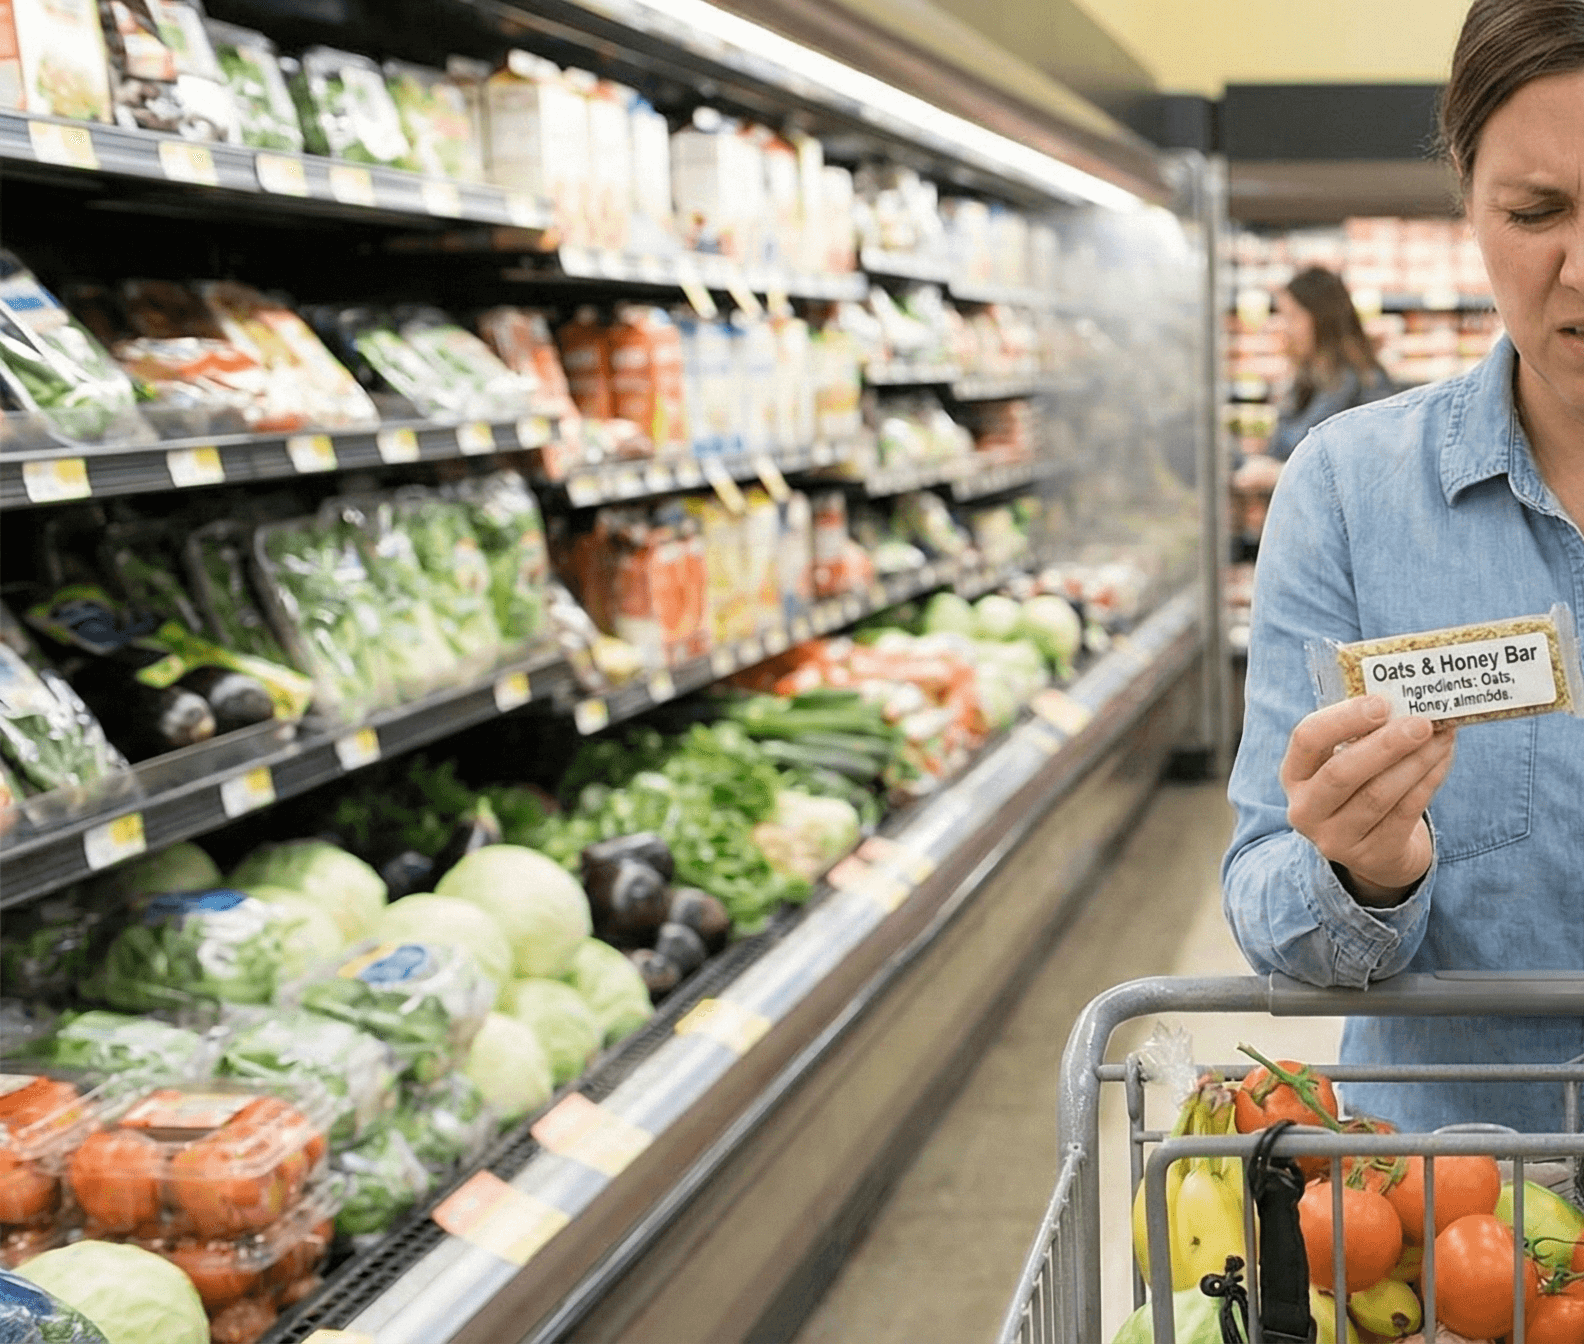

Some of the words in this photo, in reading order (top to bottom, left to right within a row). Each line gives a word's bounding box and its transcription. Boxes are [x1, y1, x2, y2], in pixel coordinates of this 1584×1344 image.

[1372, 662, 1416, 682] Oats
[1421, 657, 1436, 675] &
[1440, 652, 1499, 673] Honey
[1504, 645, 1537, 664] Bar
